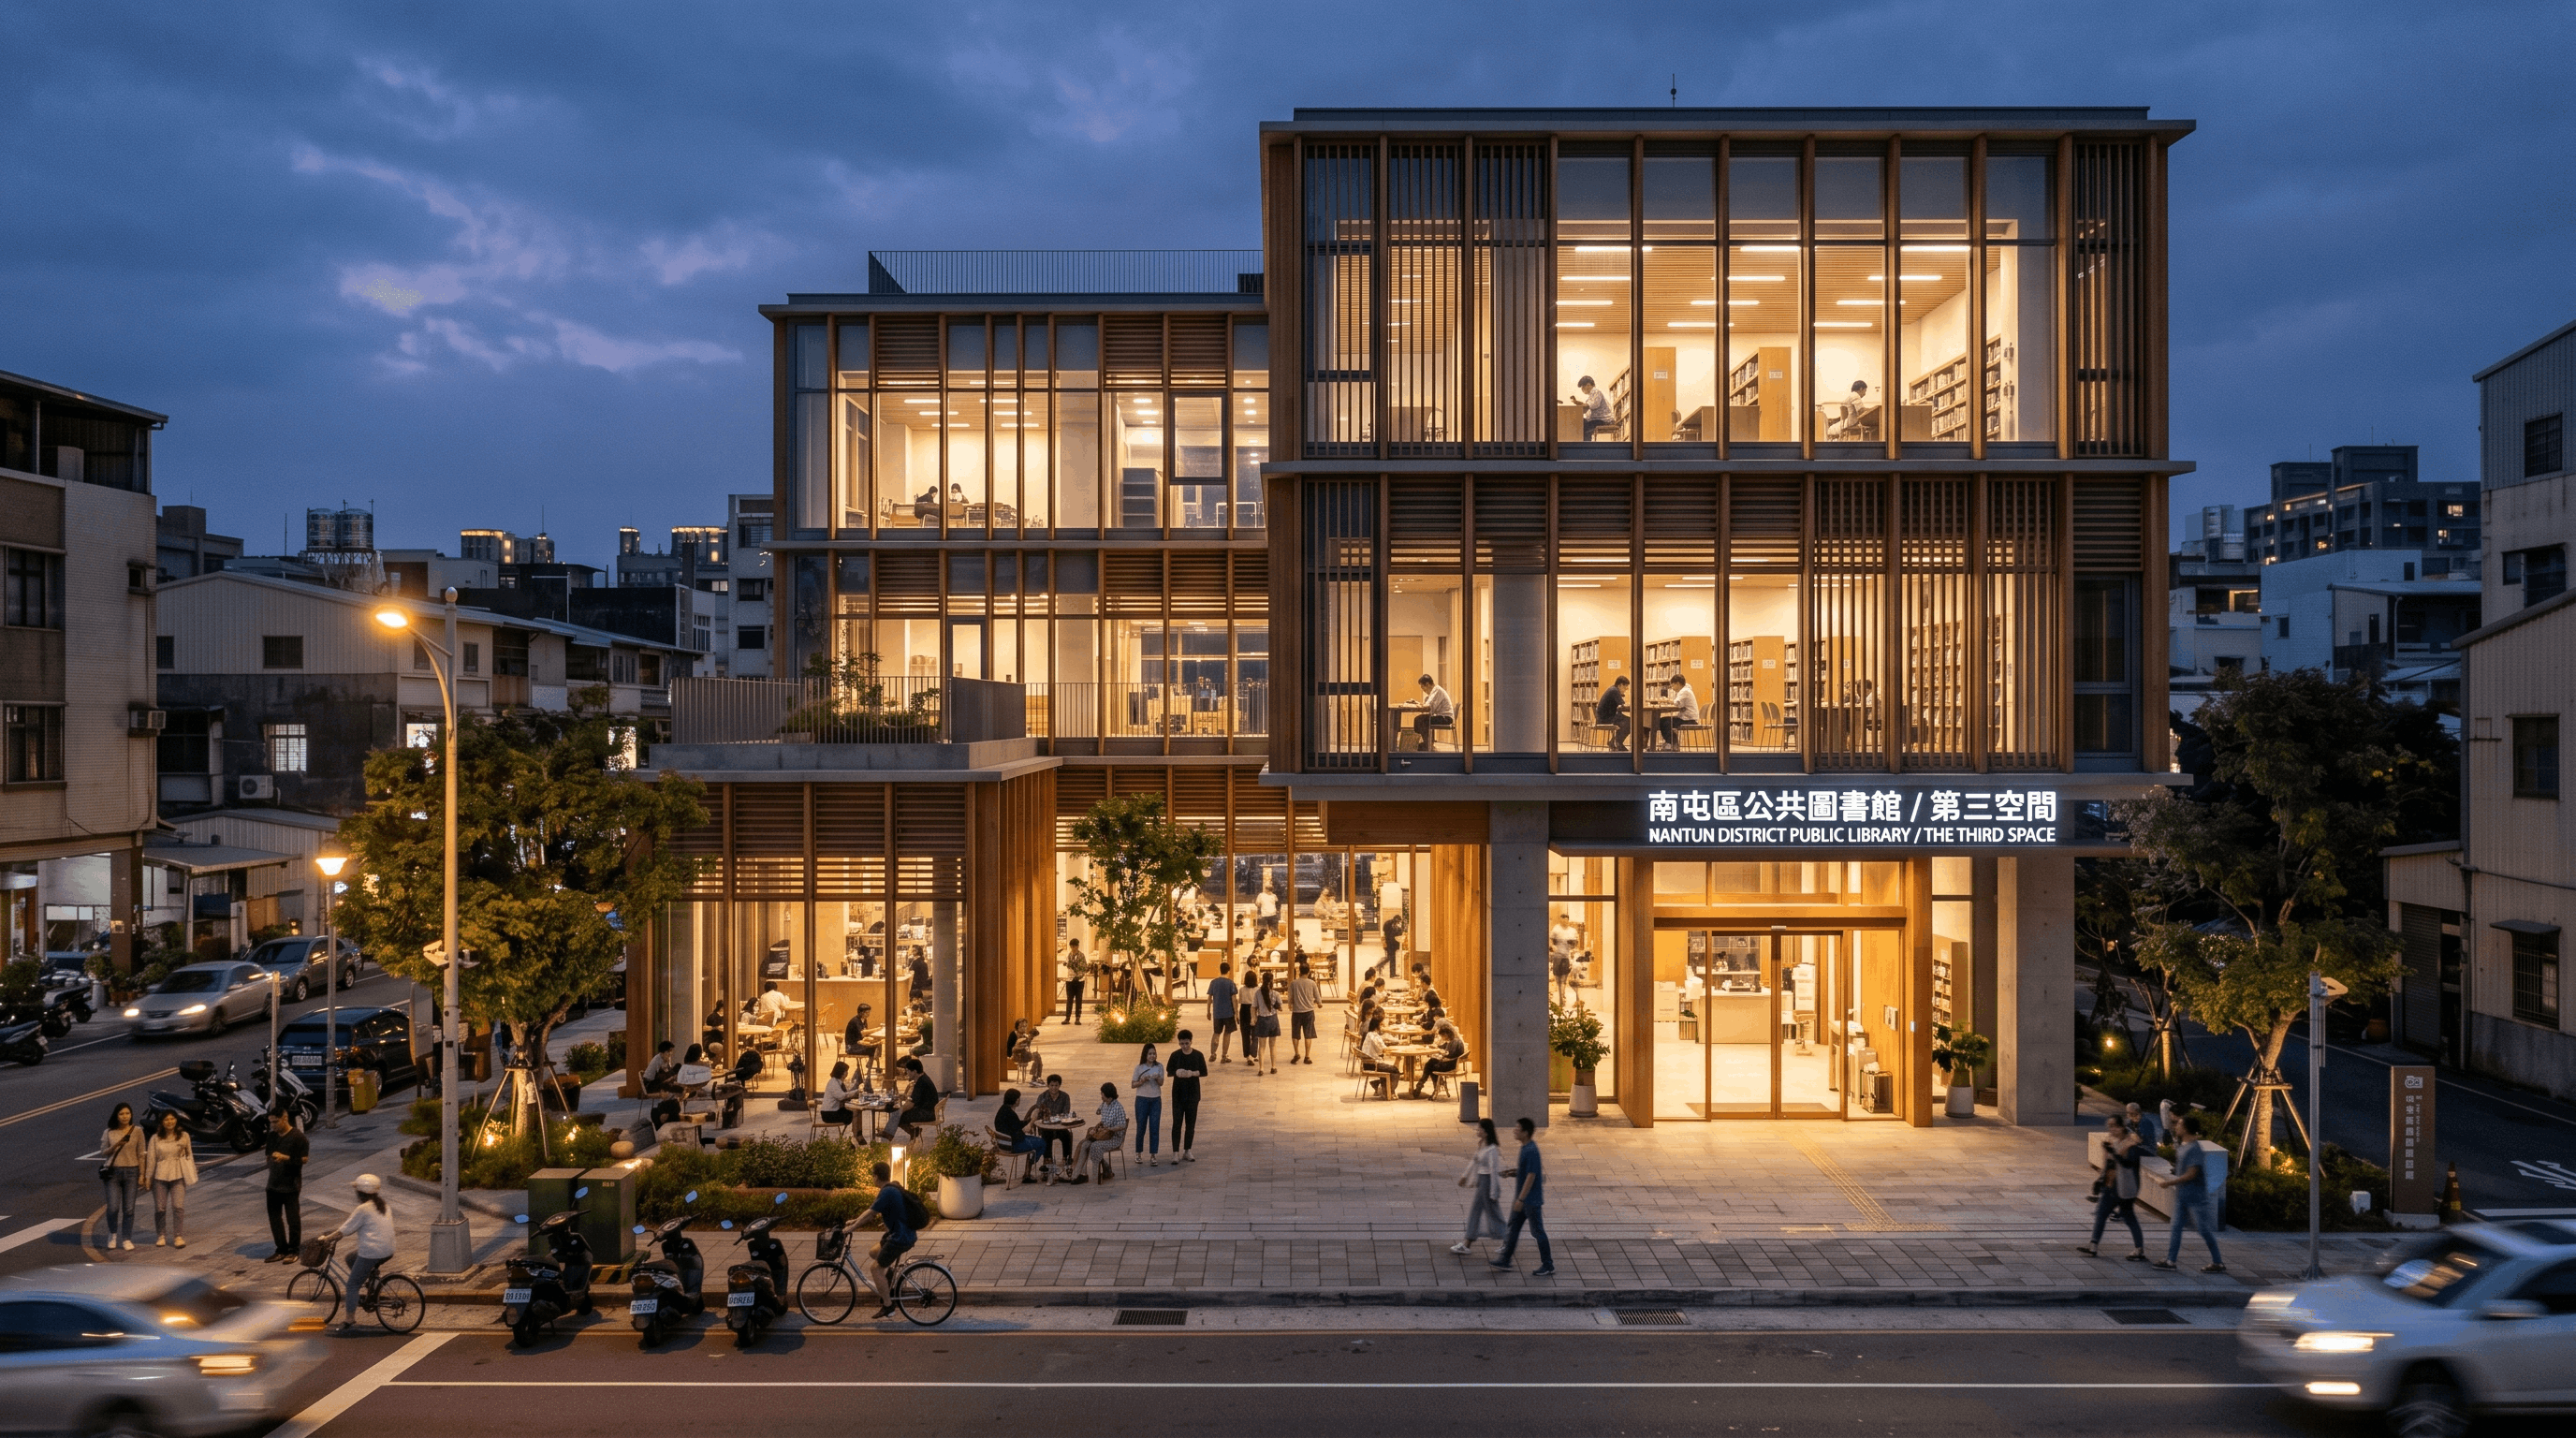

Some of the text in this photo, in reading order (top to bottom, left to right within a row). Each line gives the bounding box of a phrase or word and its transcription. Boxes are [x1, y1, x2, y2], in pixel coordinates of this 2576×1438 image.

[1648, 790, 2056, 822] 南屯區公共圖書館 / 第三空間
[1648, 828, 1714, 843] NANTUN
[1718, 828, 1787, 843] DISTRICT
[1790, 828, 1844, 843] PUBLIC
[1848, 828, 1911, 843] LIBRARY
[1924, 828, 1954, 843] THE
[1956, 828, 2003, 843] THIRD
[2007, 828, 2056, 843] SPACE
